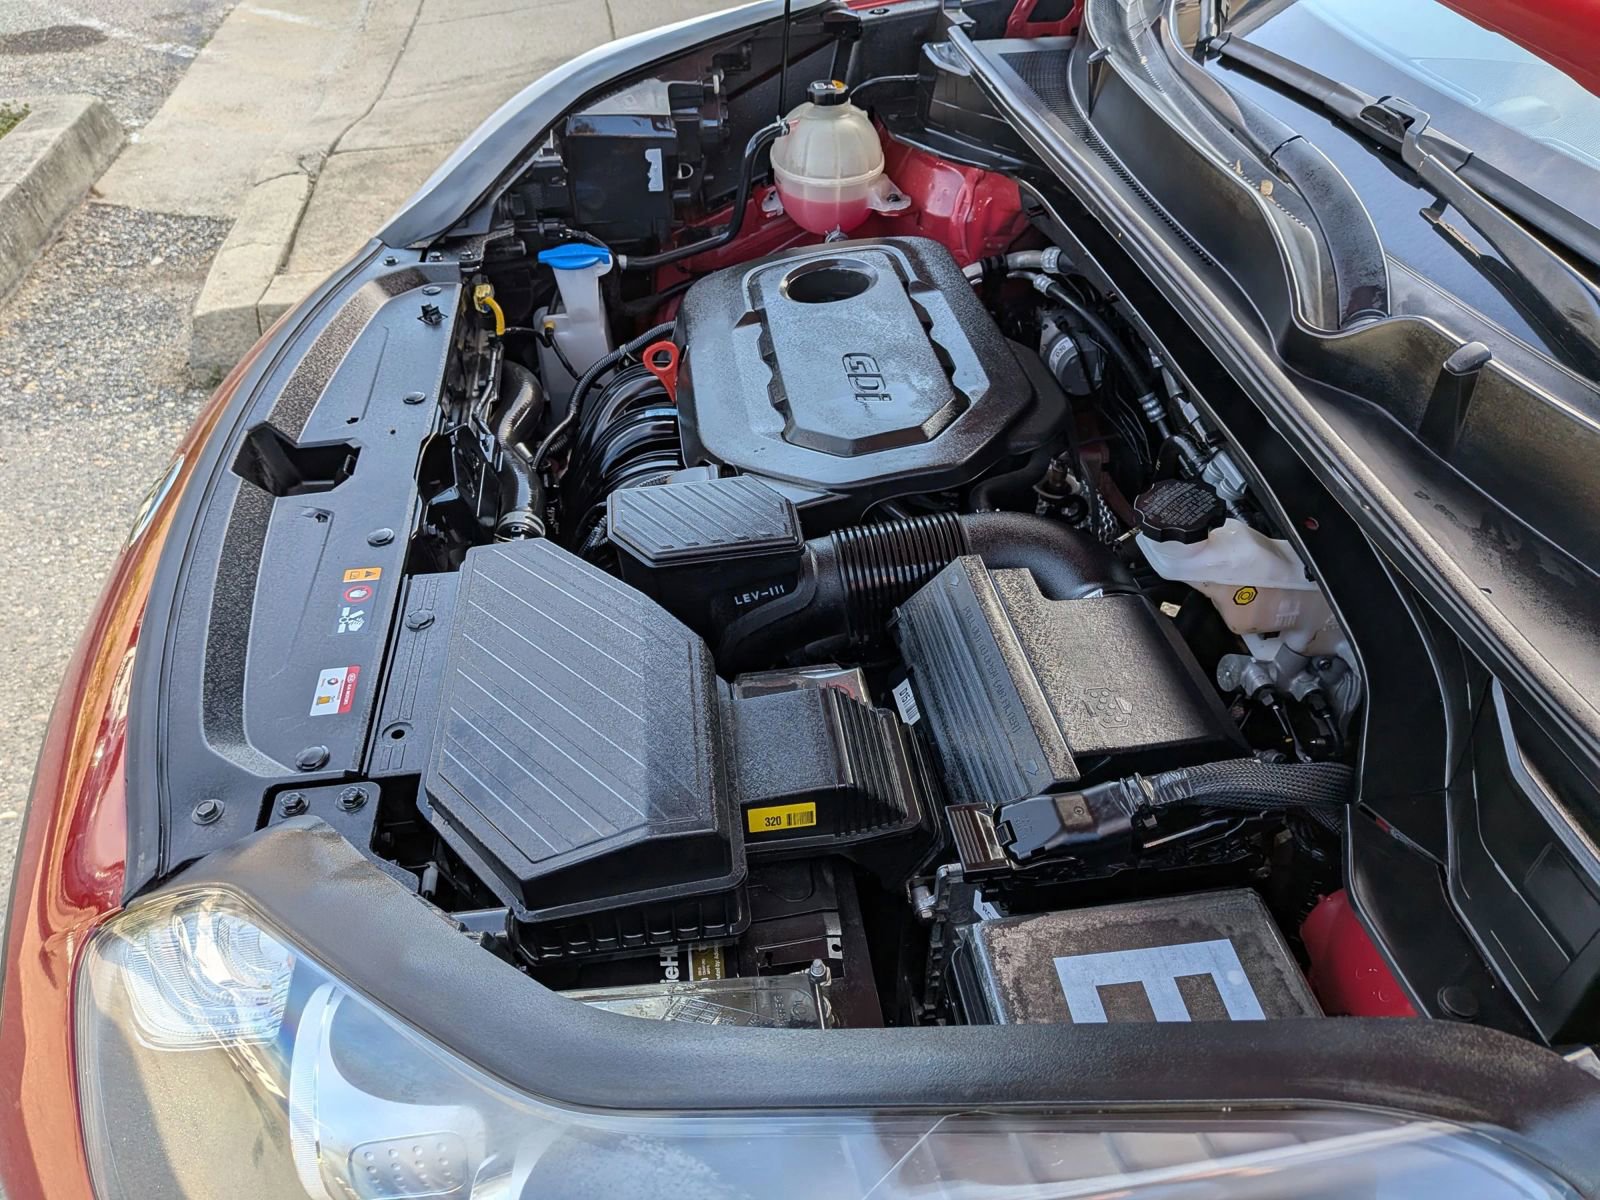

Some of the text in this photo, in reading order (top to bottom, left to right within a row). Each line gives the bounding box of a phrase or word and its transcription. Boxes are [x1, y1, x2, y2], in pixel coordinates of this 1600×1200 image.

[842, 352, 892, 402] GDi
[734, 584, 785, 605] LEV-III
[764, 816, 782, 827] 320
